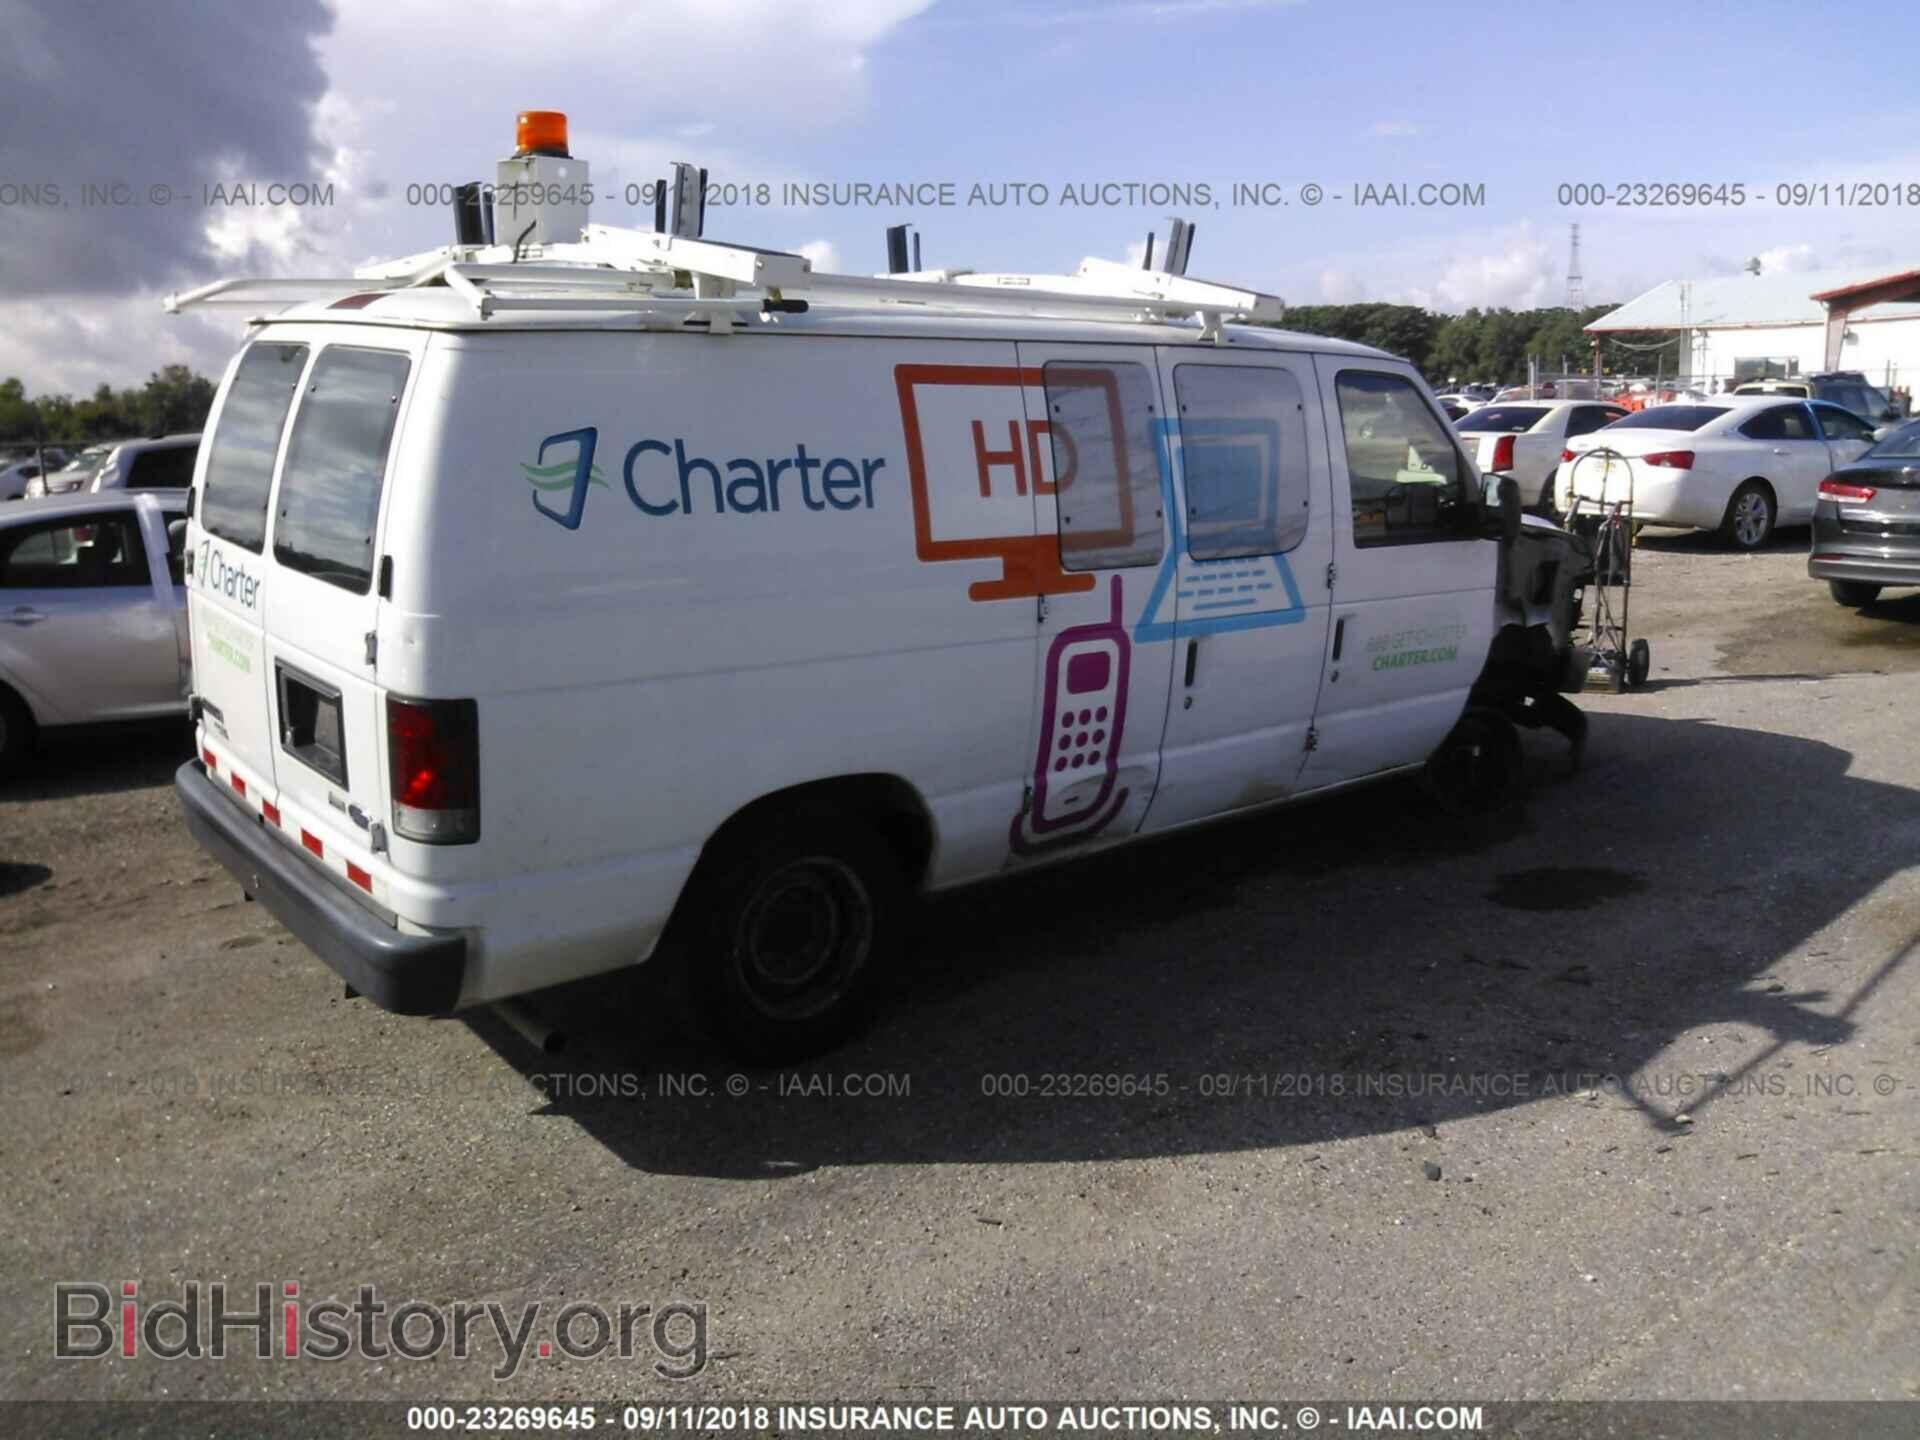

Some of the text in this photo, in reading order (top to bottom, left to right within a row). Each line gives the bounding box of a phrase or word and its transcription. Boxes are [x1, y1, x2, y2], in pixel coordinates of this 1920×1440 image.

[623, 438, 886, 516] Charter
[972, 420, 1078, 497] HD
[210, 551, 260, 609] Charter
